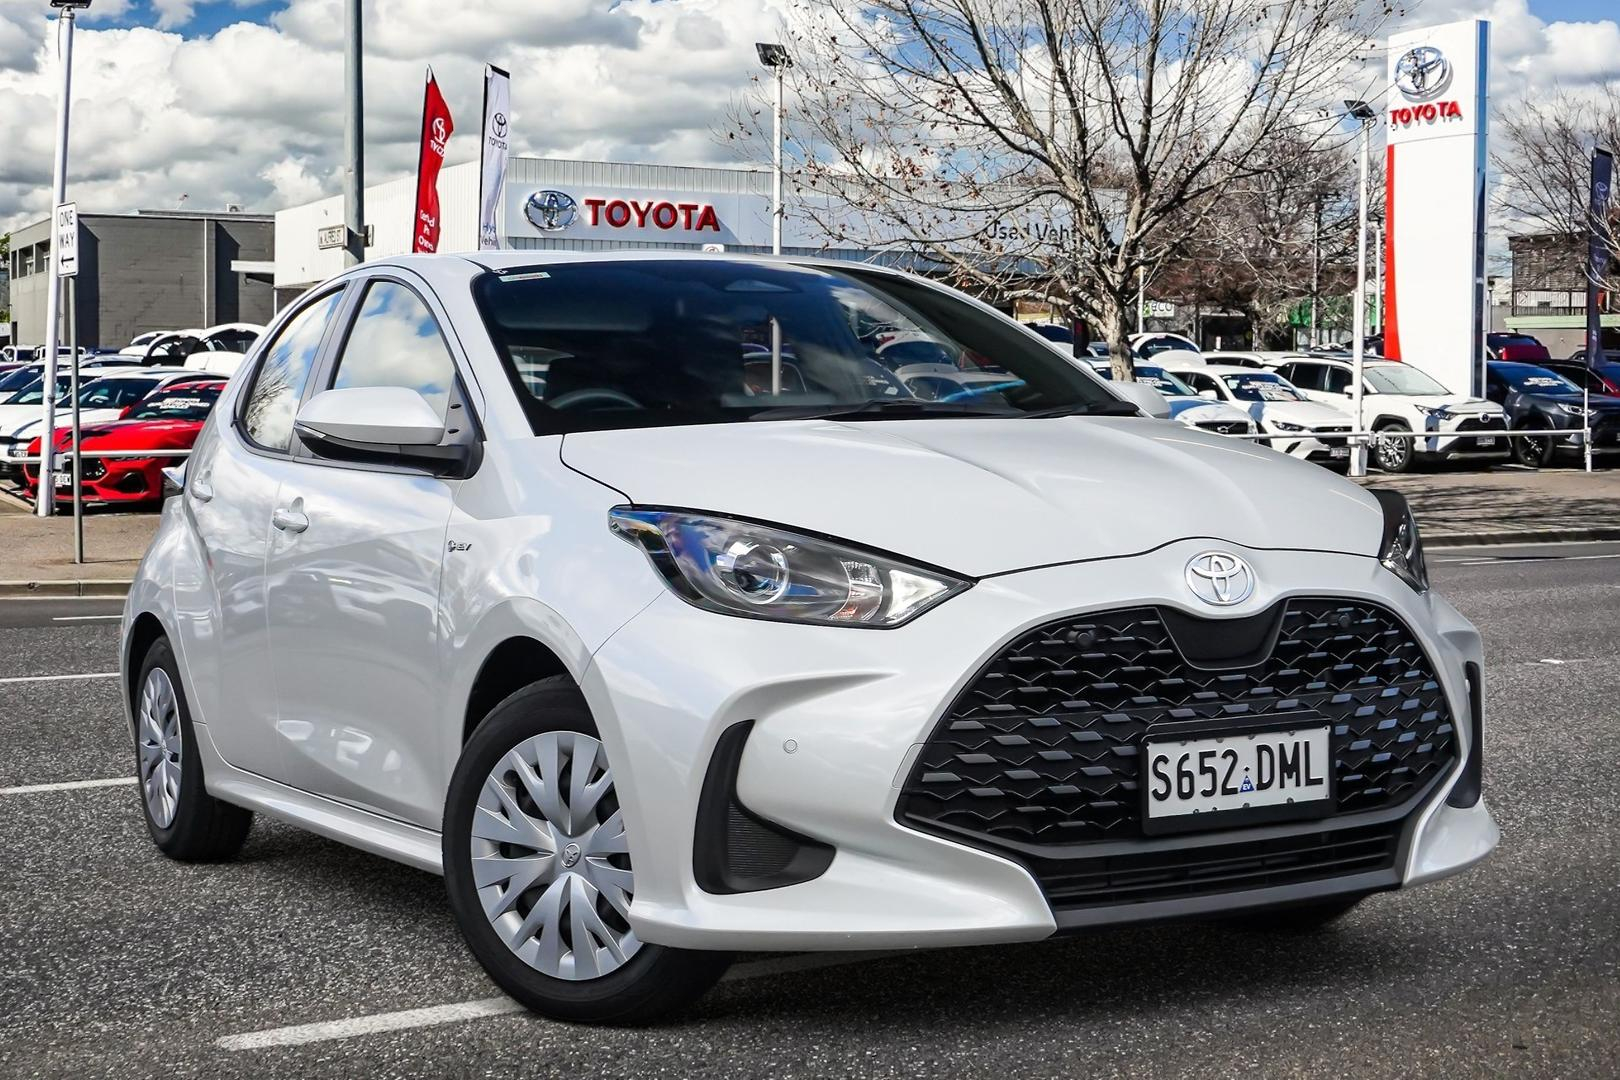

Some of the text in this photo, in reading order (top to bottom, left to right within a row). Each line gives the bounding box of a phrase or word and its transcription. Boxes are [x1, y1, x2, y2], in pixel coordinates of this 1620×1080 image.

[1390, 101, 1461, 125] TOYOTA
[488, 136, 507, 150] TOYOTA
[60, 210, 74, 227] ONE
[584, 199, 720, 232] TOYOTA
[60, 231, 75, 248] WAY
[984, 218, 1031, 240] Used
[1152, 741, 1323, 801] S652 DML
